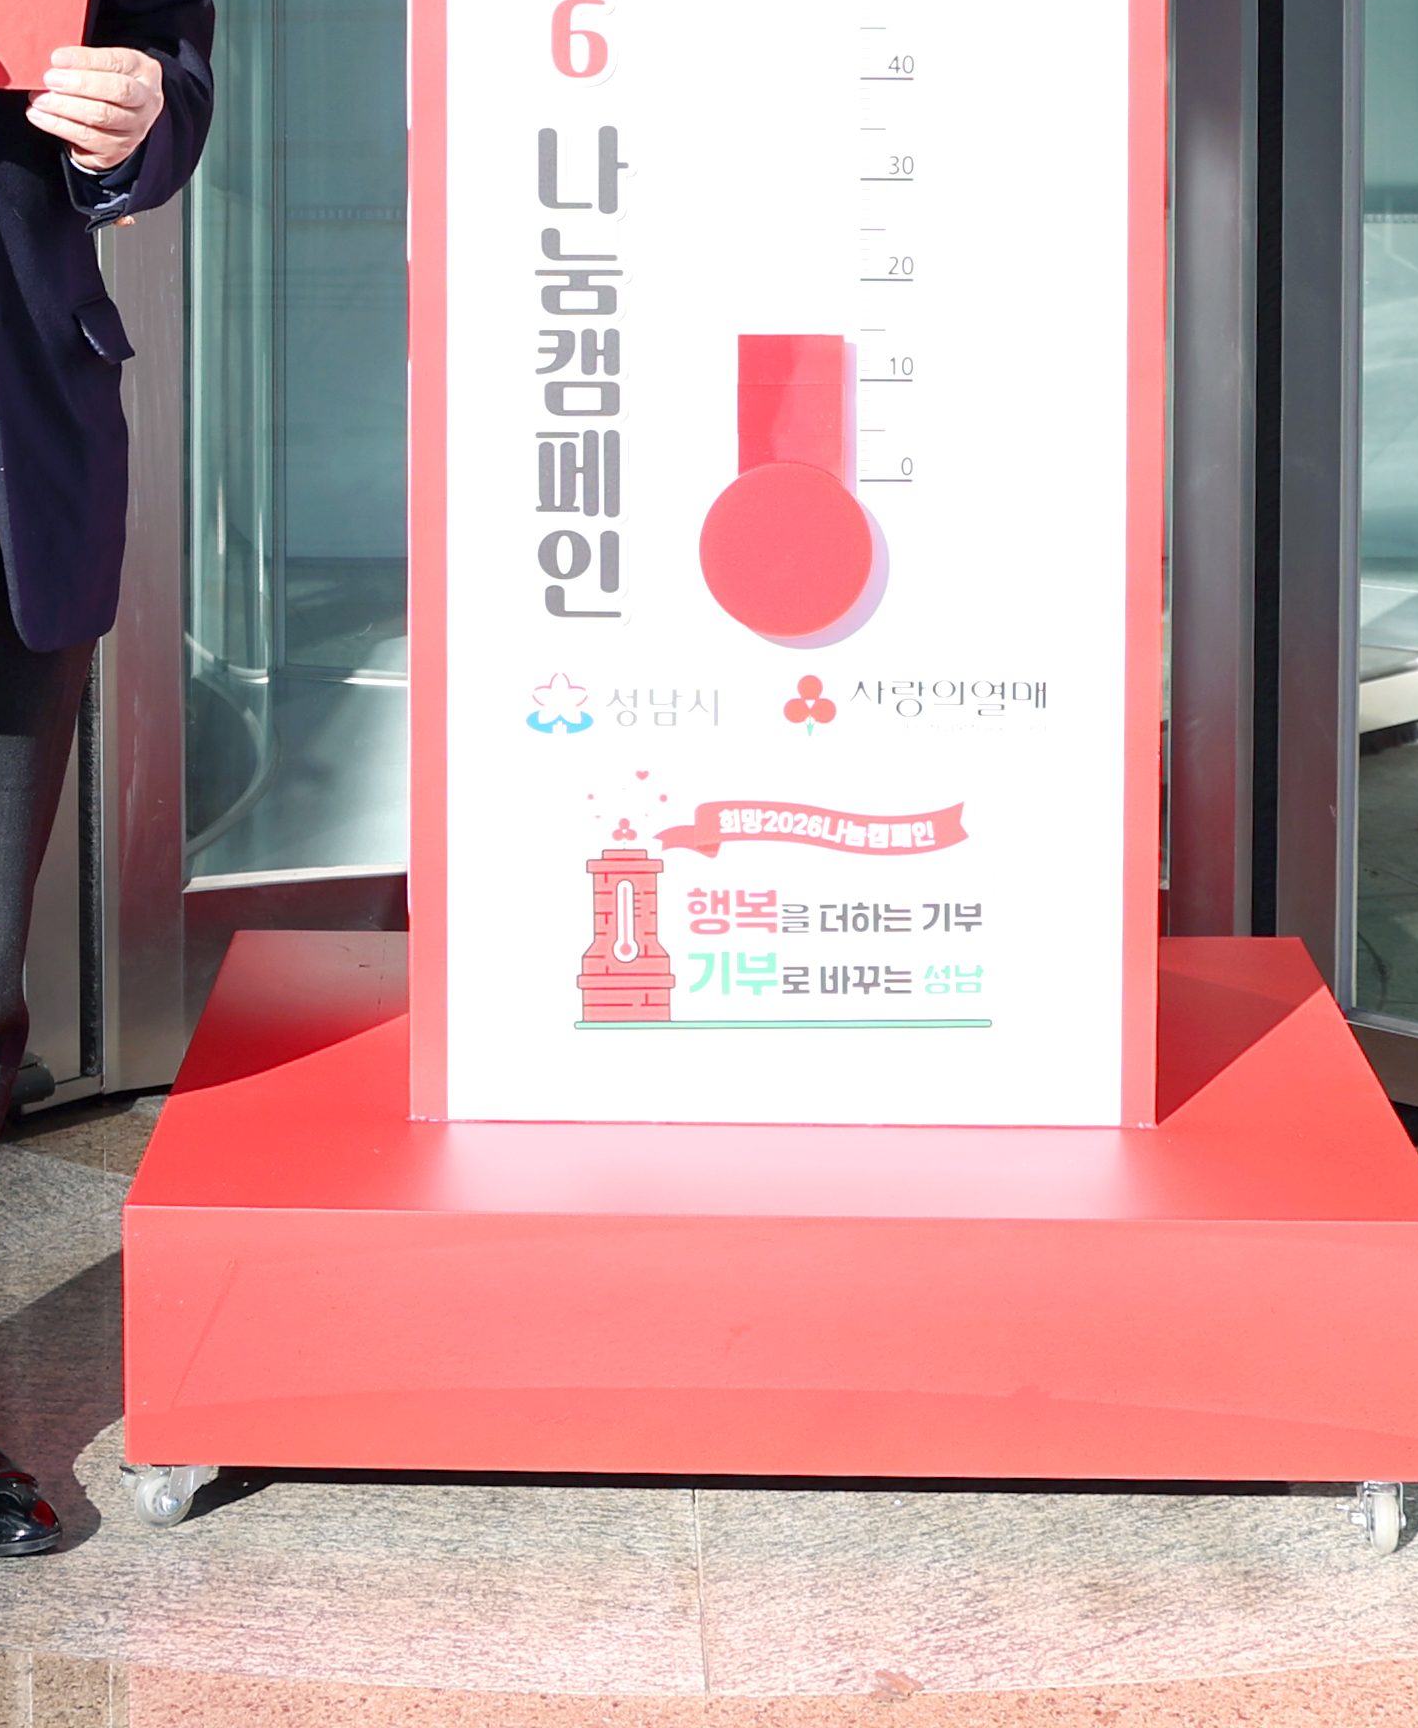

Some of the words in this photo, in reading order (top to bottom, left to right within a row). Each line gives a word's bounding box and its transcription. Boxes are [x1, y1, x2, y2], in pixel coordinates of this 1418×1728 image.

[887, 55, 914, 74] 40
[888, 156, 914, 175] 30
[887, 256, 914, 275] 20
[535, 125, 629, 619] 나눔캠페인
[889, 357, 913, 376] 10
[900, 457, 914, 476] 0
[605, 687, 720, 727] 성남시
[849, 679, 1048, 717] 사랑의열매
[718, 808, 936, 849] 희망2026나눔캠페인
[686, 887, 810, 935] 행복을
[819, 901, 913, 933] 더하는
[921, 902, 983, 933] 기부
[687, 950, 811, 997] 기부로
[819, 965, 913, 995] 바꾸는
[922, 964, 985, 995] 성남
